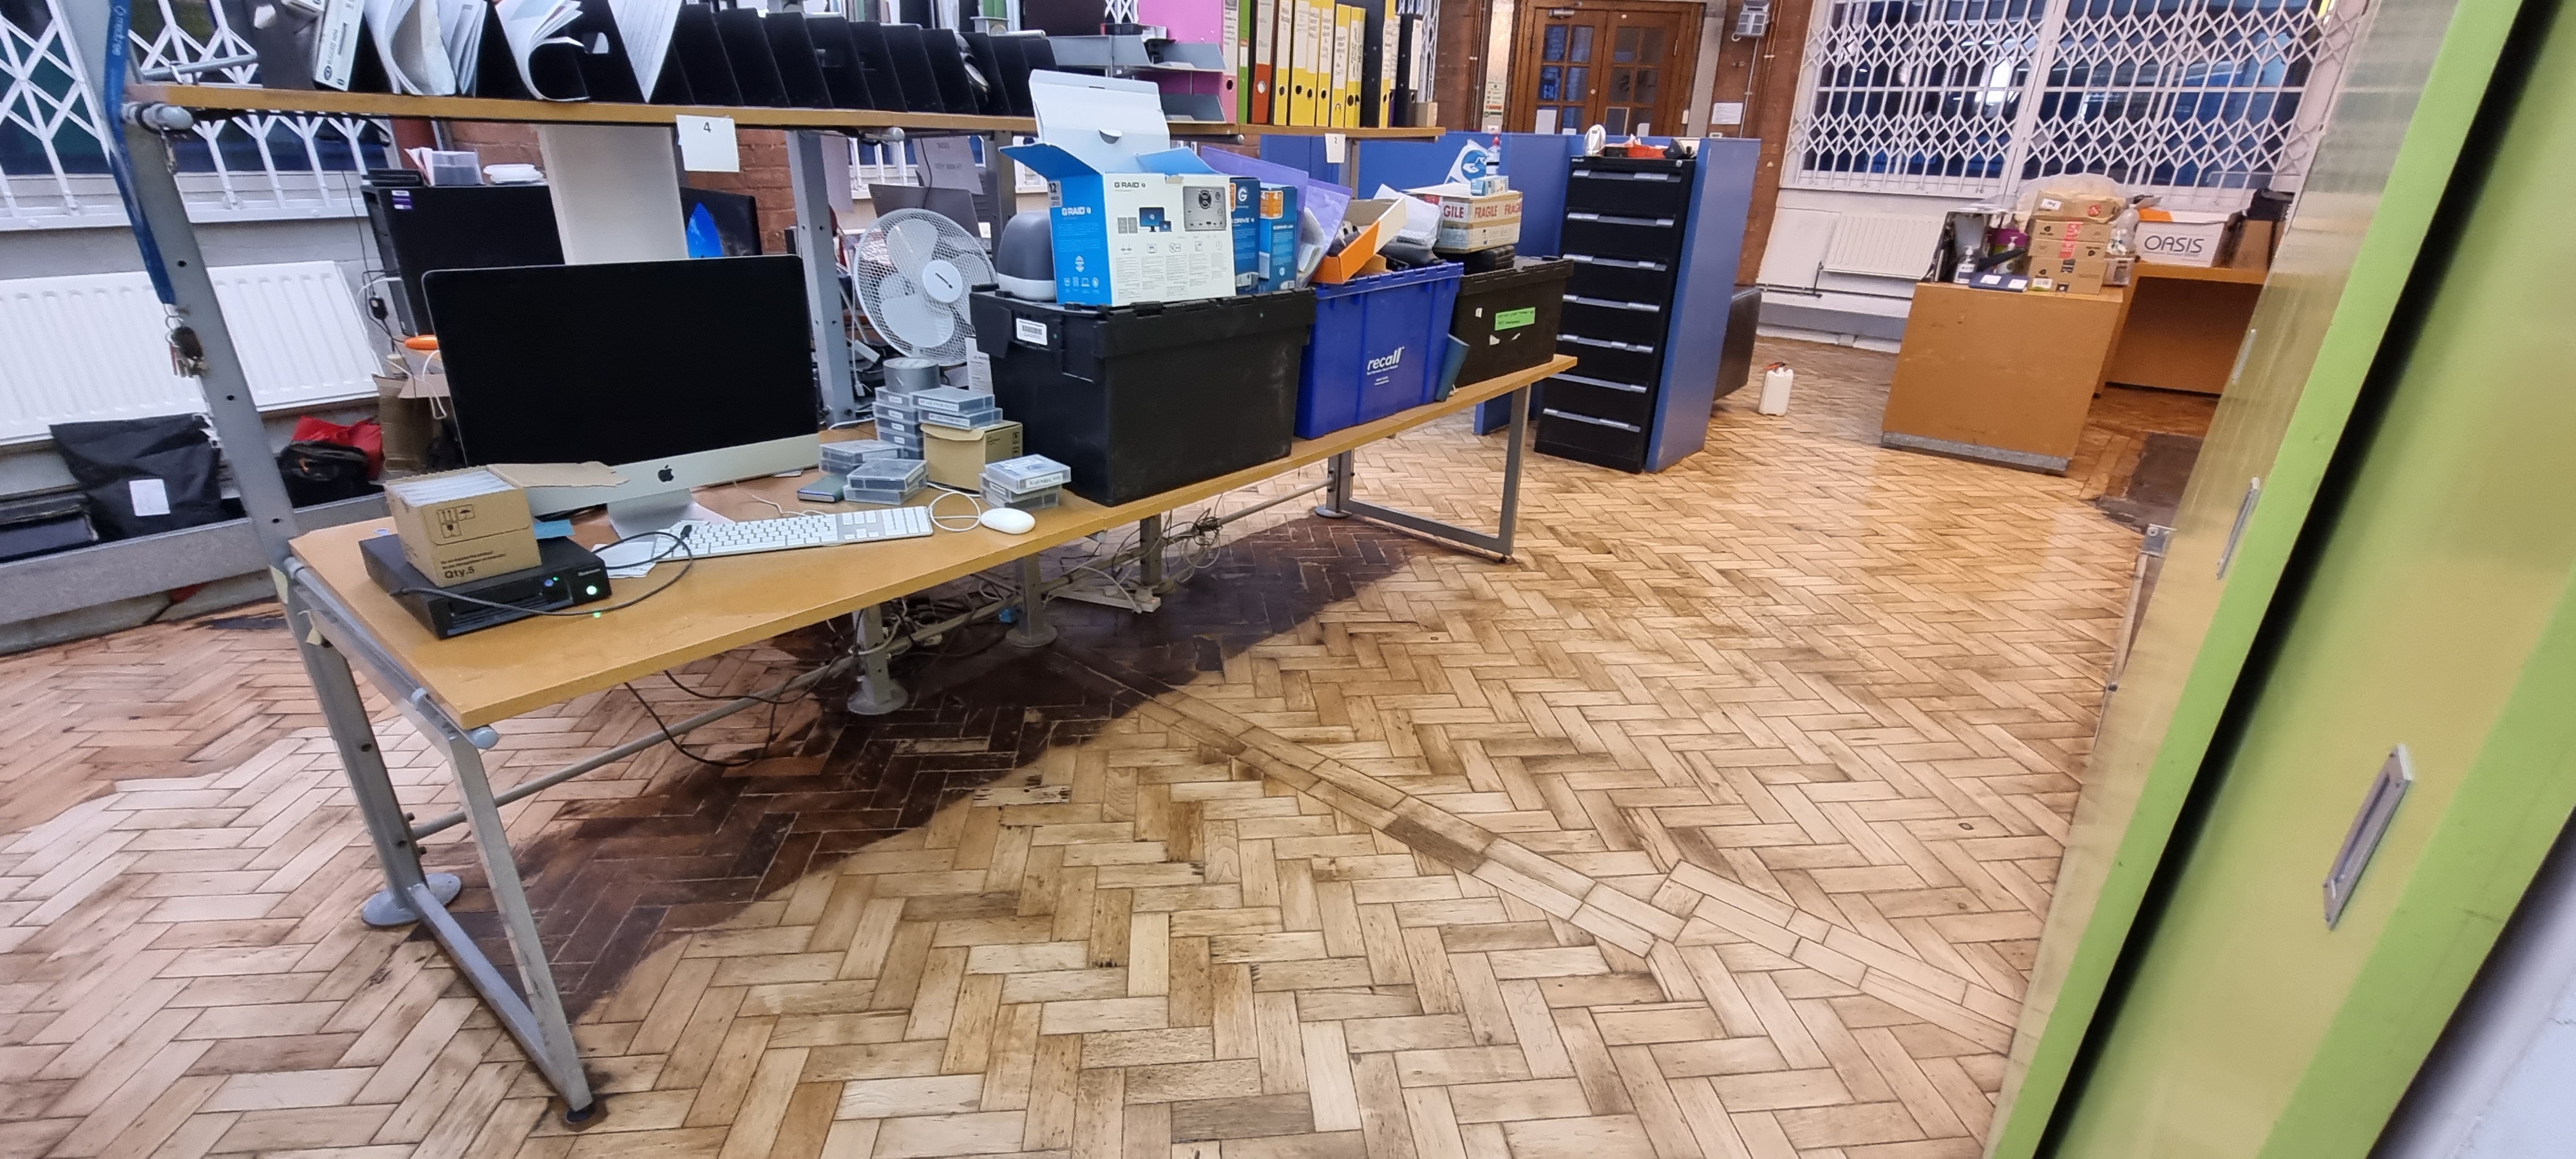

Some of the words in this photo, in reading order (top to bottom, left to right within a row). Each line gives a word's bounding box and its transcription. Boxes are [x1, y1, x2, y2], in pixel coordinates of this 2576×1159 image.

[703, 122, 712, 133] 4
[1474, 205, 1498, 219] FRAGILE
[2144, 235, 2205, 253] OASIS
[1367, 347, 1402, 371] recall
